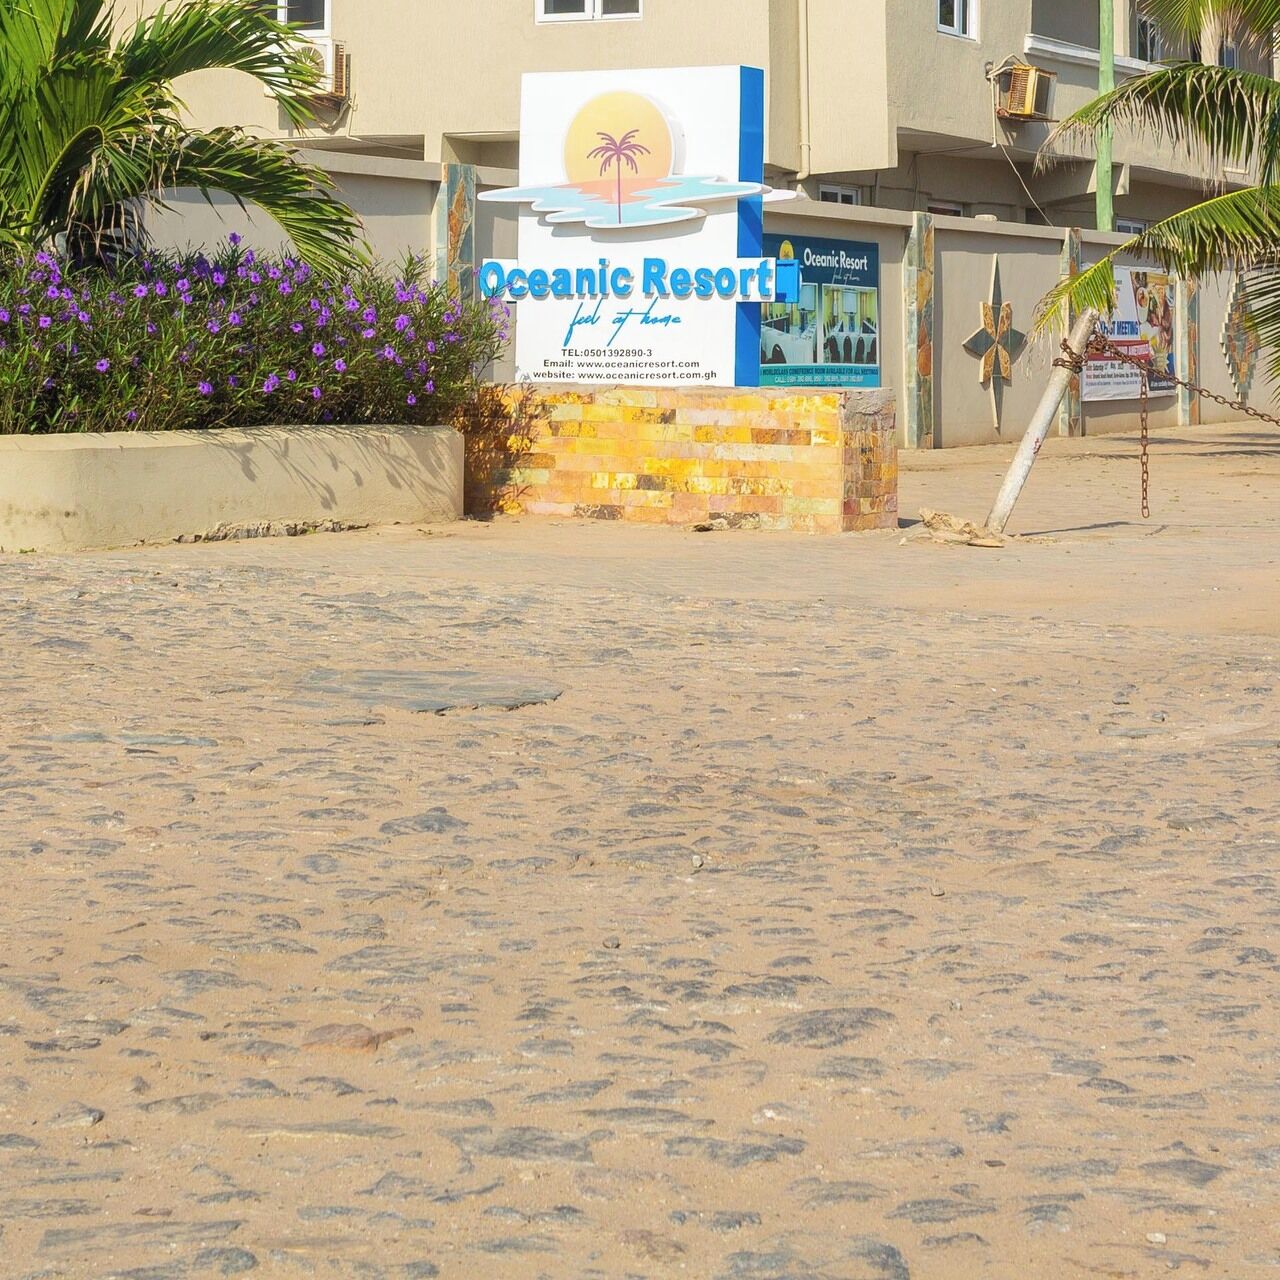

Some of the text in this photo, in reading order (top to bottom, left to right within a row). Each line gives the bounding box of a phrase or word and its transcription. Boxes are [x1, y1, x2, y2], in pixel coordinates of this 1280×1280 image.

[803, 247, 868, 271] Oceanic Resort
[480, 257, 773, 297] Oceanic Resort
[564, 297, 682, 347] feel at home
[1116, 321, 1140, 336] MEETING
[561, 349, 653, 357] TEL:0501392890-3
[543, 359, 700, 368] Email: www.oceanicresort.com
[533, 370, 717, 380] website: www.oceanicresort.com.gh
